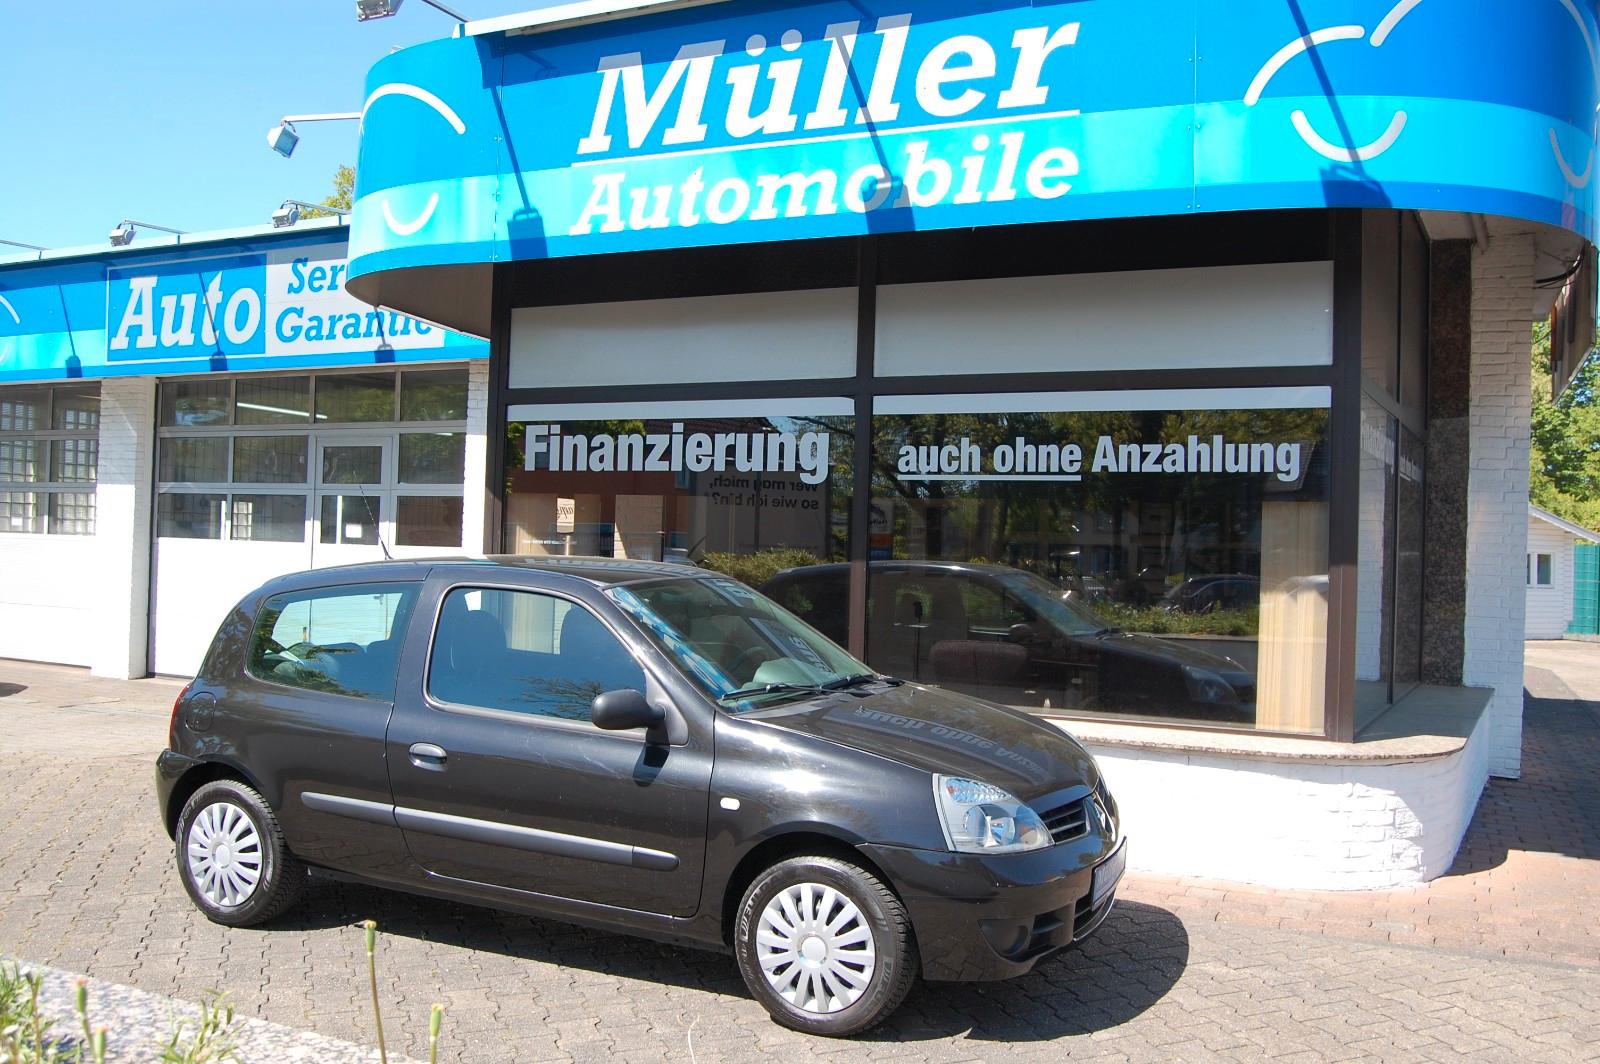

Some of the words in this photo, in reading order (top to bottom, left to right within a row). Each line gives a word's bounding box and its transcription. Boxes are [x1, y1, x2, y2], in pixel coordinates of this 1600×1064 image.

[577, 13, 1080, 154] Müller
[569, 132, 1080, 236] Automobile
[111, 271, 262, 351] Auto
[287, 257, 346, 295] Ser
[524, 422, 830, 485] Finanzierung
[898, 437, 981, 474] auch
[993, 436, 1082, 473] ohne
[1091, 435, 1301, 482] Anzahlung
